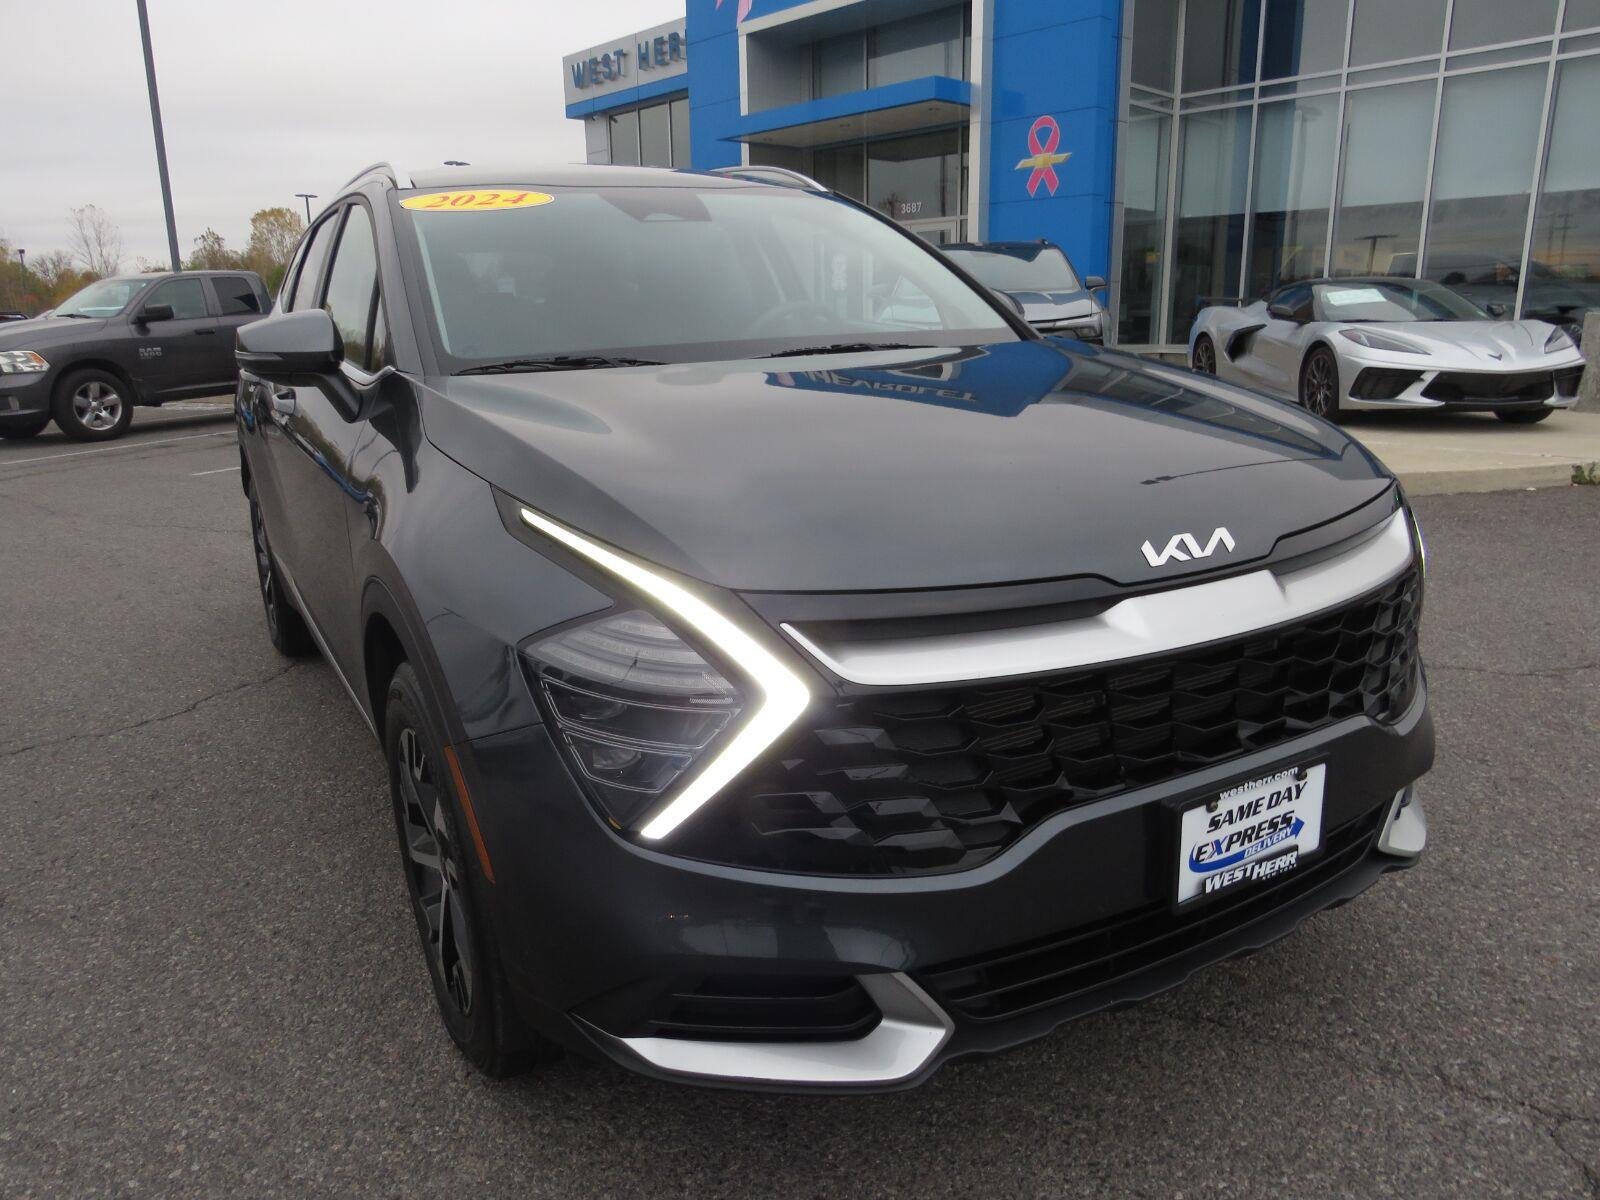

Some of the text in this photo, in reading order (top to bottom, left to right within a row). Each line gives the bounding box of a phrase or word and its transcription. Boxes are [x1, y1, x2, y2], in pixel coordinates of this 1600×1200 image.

[571, 29, 687, 89] WEST HER
[424, 193, 528, 208] 2024
[901, 201, 922, 214] 3687
[1219, 766, 1299, 800] westherr.com
[1206, 781, 1309, 834] SAME DAY
[1194, 810, 1295, 862] EXPRESS
[1243, 826, 1294, 859] DELIVERY
